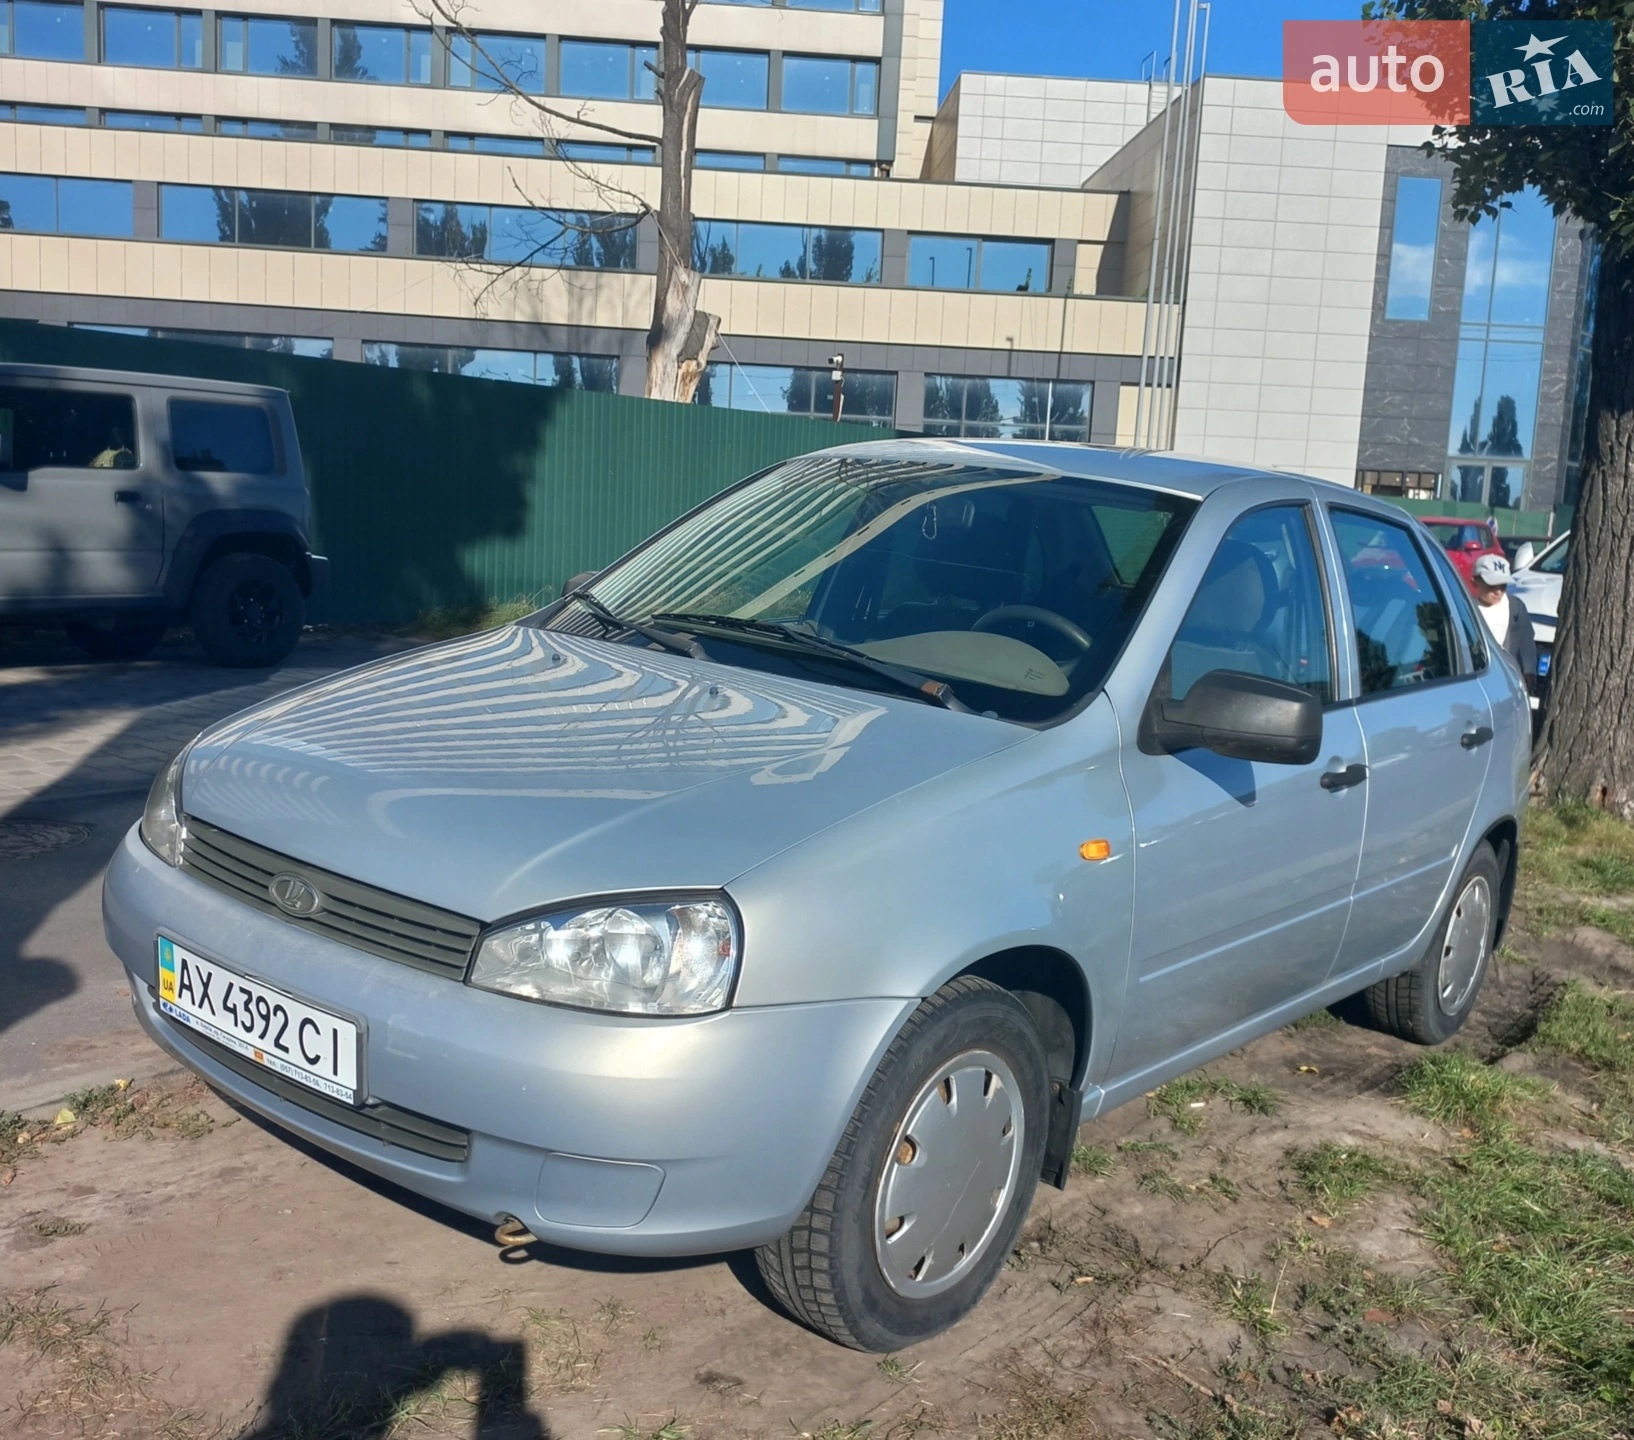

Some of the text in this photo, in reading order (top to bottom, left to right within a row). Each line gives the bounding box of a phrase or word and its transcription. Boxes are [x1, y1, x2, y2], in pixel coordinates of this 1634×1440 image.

[162, 977, 175, 994] UA
[174, 1008, 191, 1024] LADA
[177, 957, 217, 1017] AX
[222, 981, 290, 1055] 4392
[298, 1017, 339, 1077] CI
